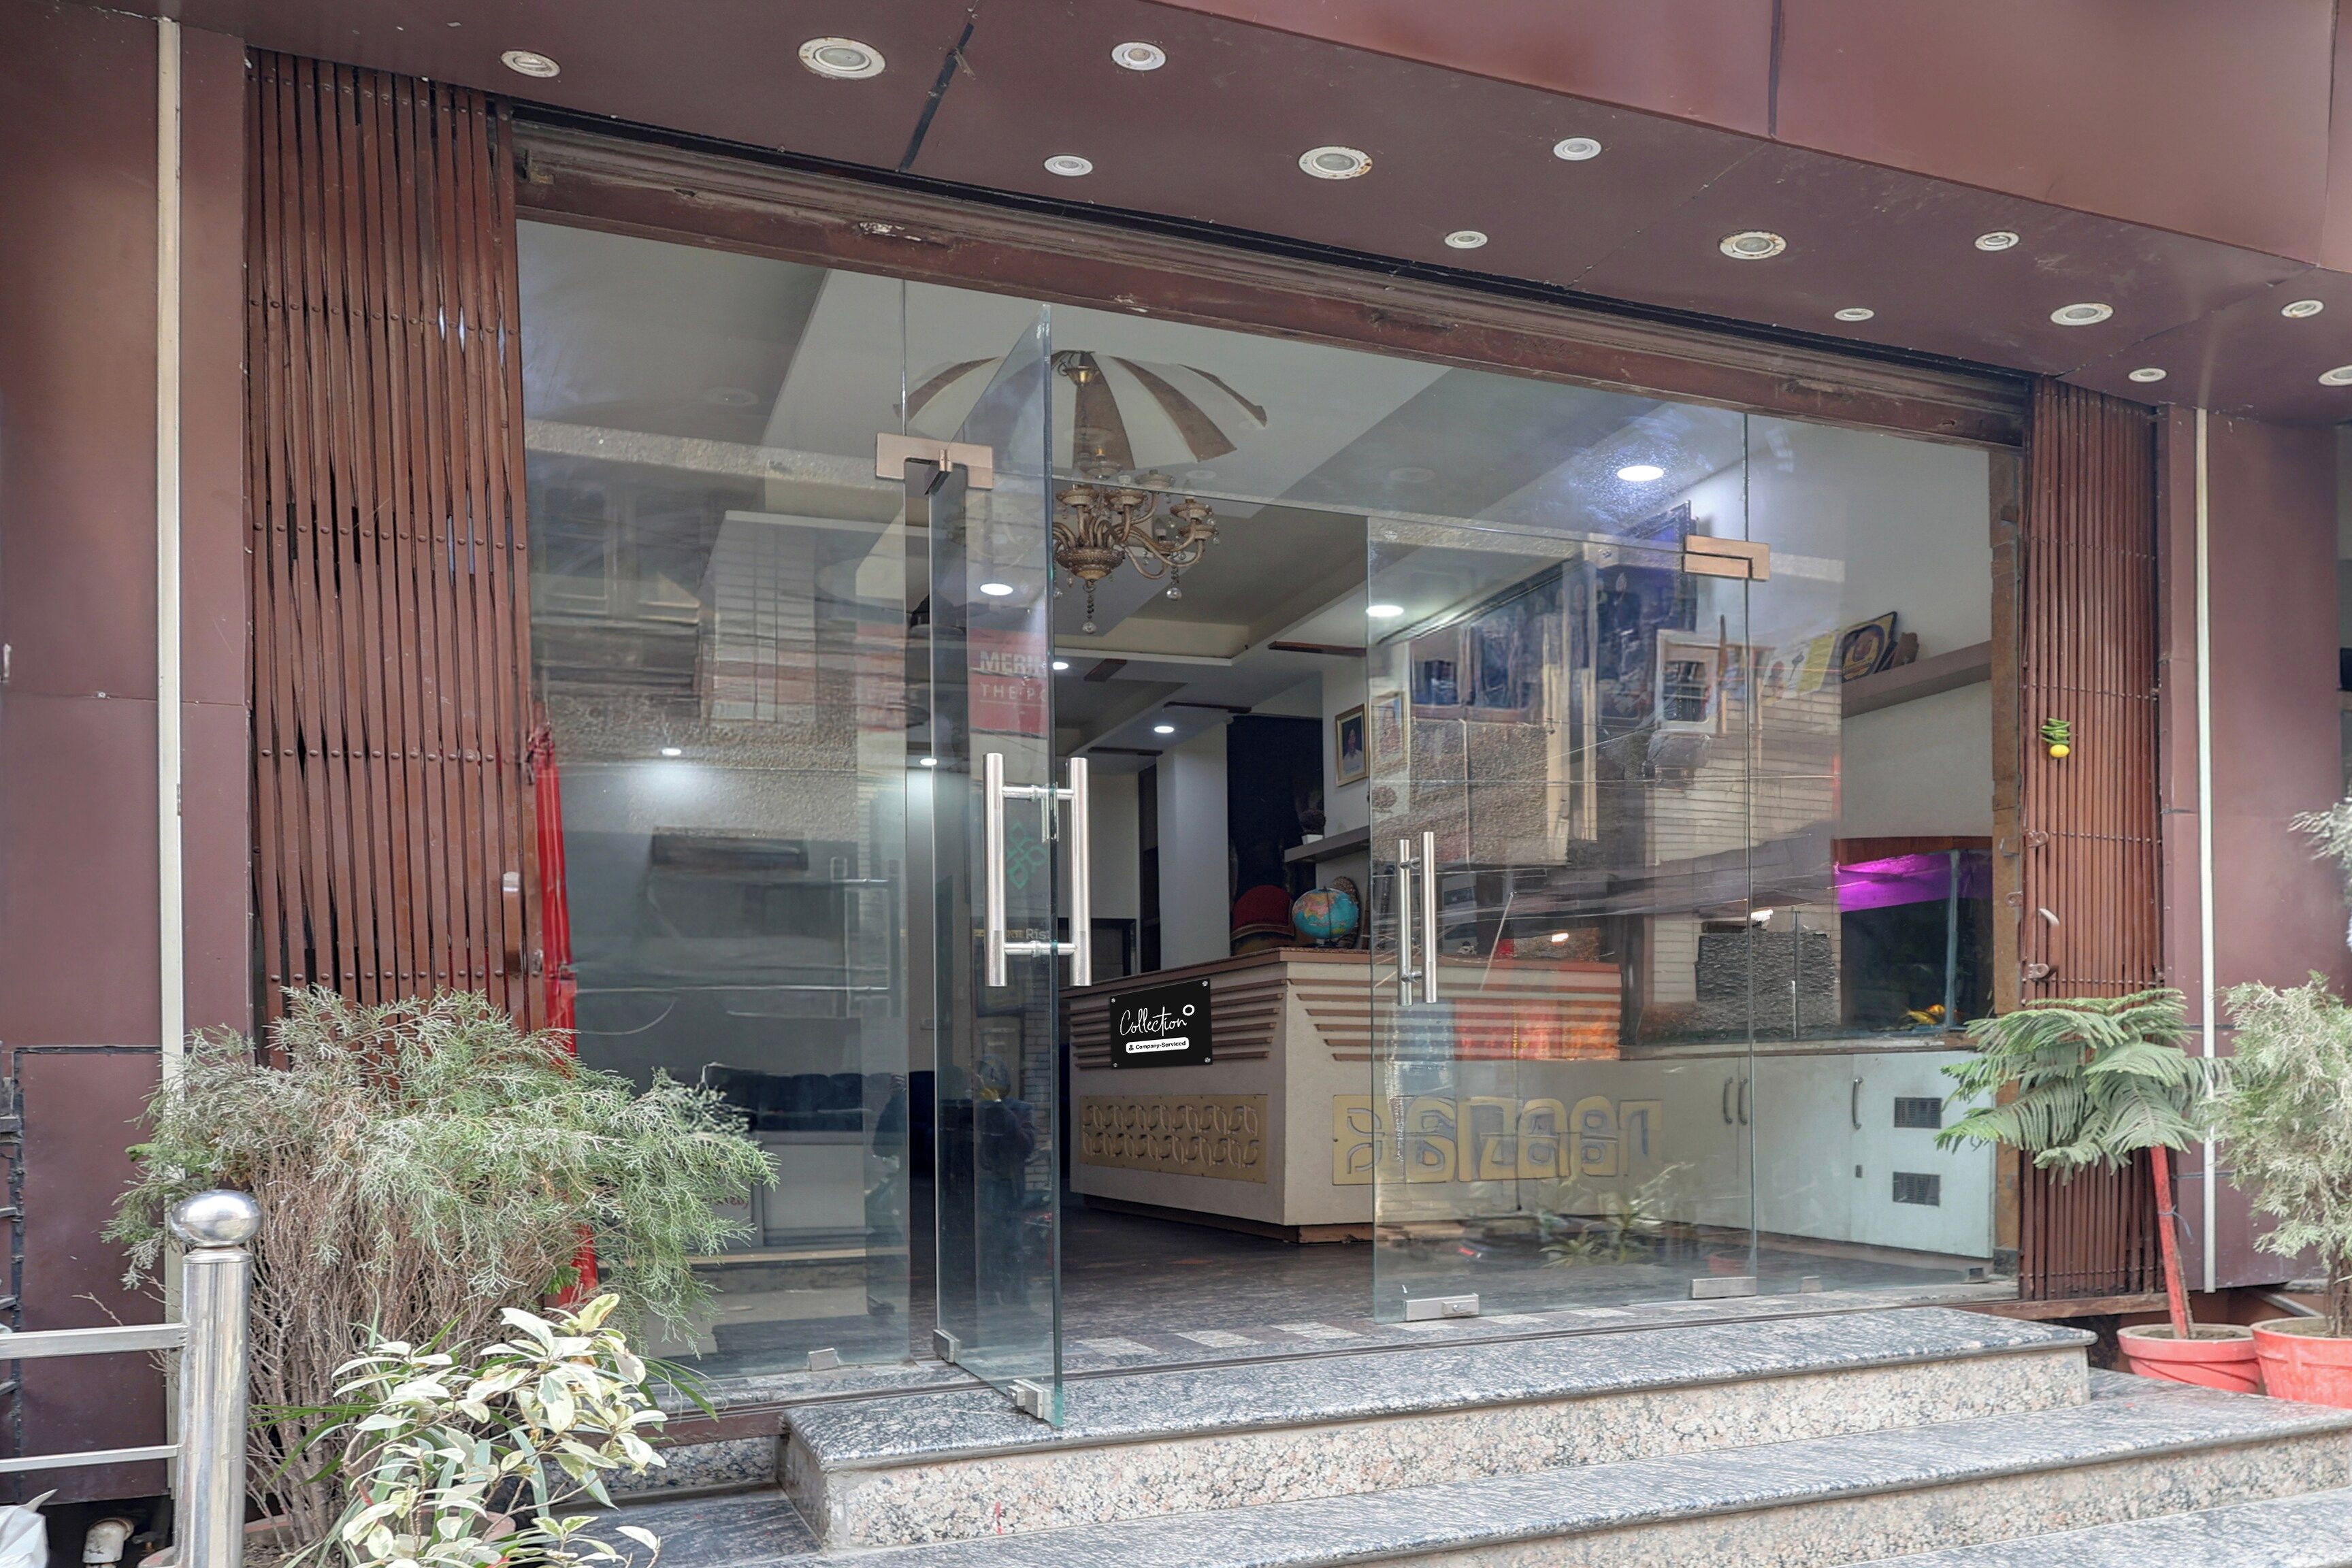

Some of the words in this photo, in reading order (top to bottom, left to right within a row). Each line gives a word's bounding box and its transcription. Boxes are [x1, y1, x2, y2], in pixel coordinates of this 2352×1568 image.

[980, 683, 1017, 700] THE
[1120, 1006, 1188, 1036] Collection
[1135, 1040, 1186, 1050] Company-Serviced
